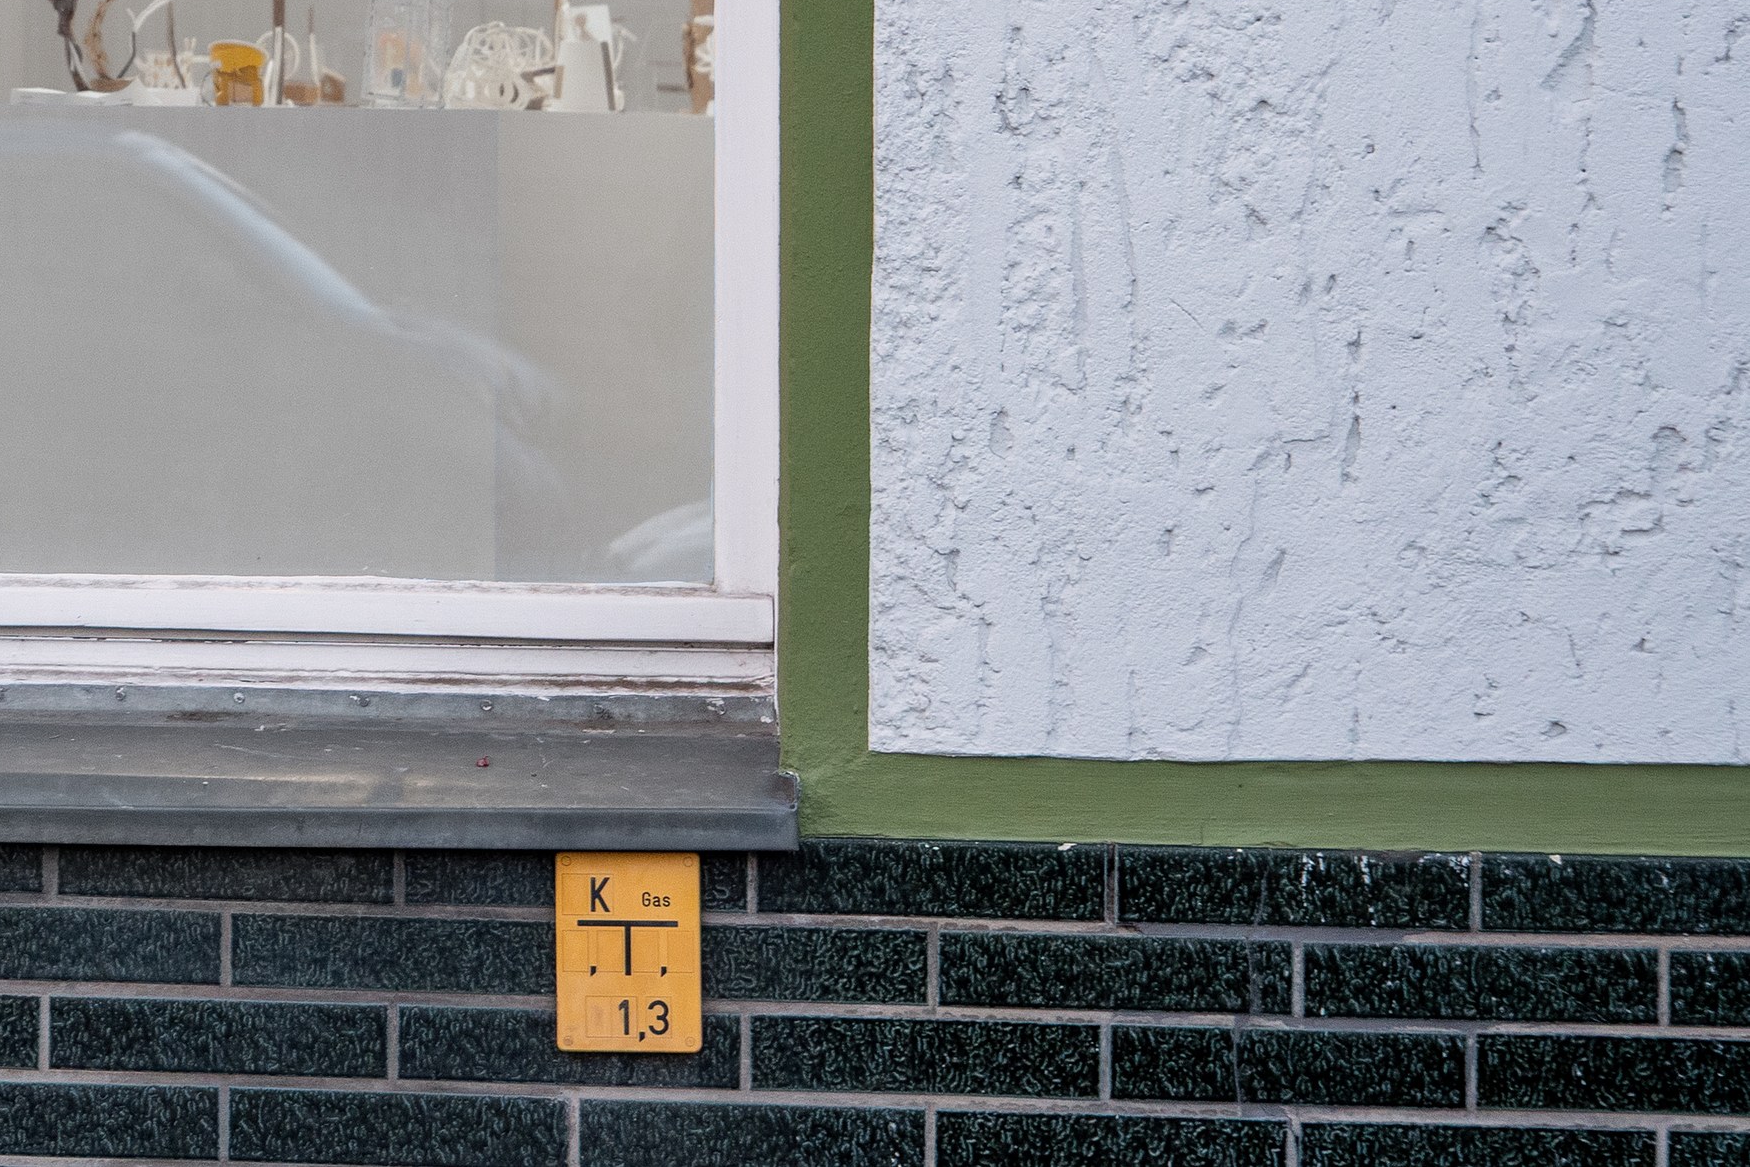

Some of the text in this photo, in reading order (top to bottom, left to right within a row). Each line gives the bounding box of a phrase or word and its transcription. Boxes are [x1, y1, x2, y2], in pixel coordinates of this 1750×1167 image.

[590, 877, 671, 912] K Gas
[618, 999, 669, 1042] 1,3
